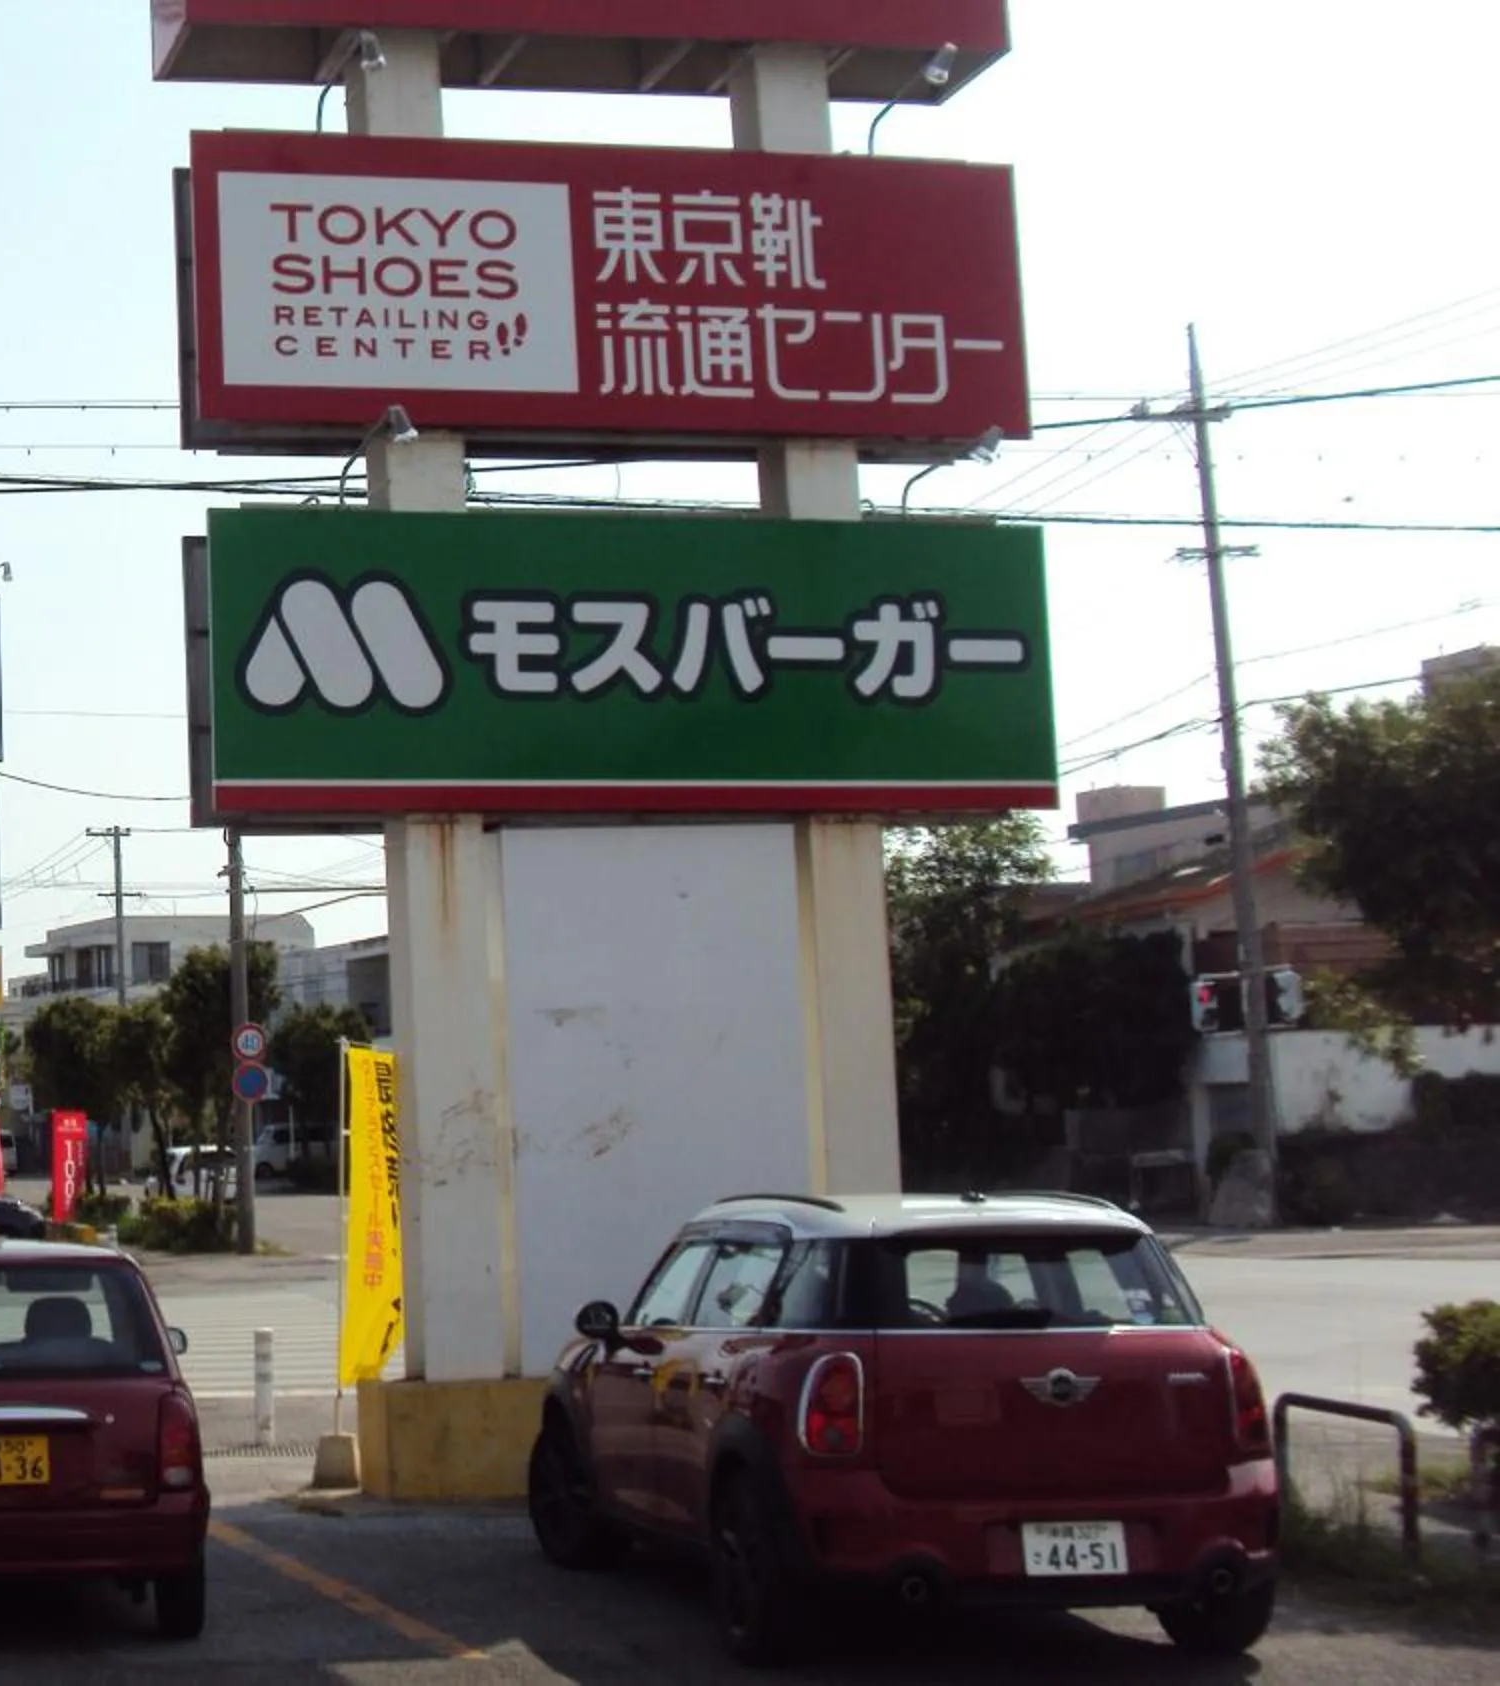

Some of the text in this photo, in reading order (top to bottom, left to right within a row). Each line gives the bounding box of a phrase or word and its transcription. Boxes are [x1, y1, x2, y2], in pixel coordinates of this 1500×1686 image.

[269, 203, 517, 250] TOKYO
[592, 186, 827, 290] 東京靴
[272, 253, 519, 300] SHOES
[274, 304, 488, 331] RETAILING
[274, 335, 492, 361] CENTER
[596, 298, 1004, 405] 流通センター
[468, 596, 1026, 700] モスバーガー
[1047, 1541, 1119, 1572] 44-51
